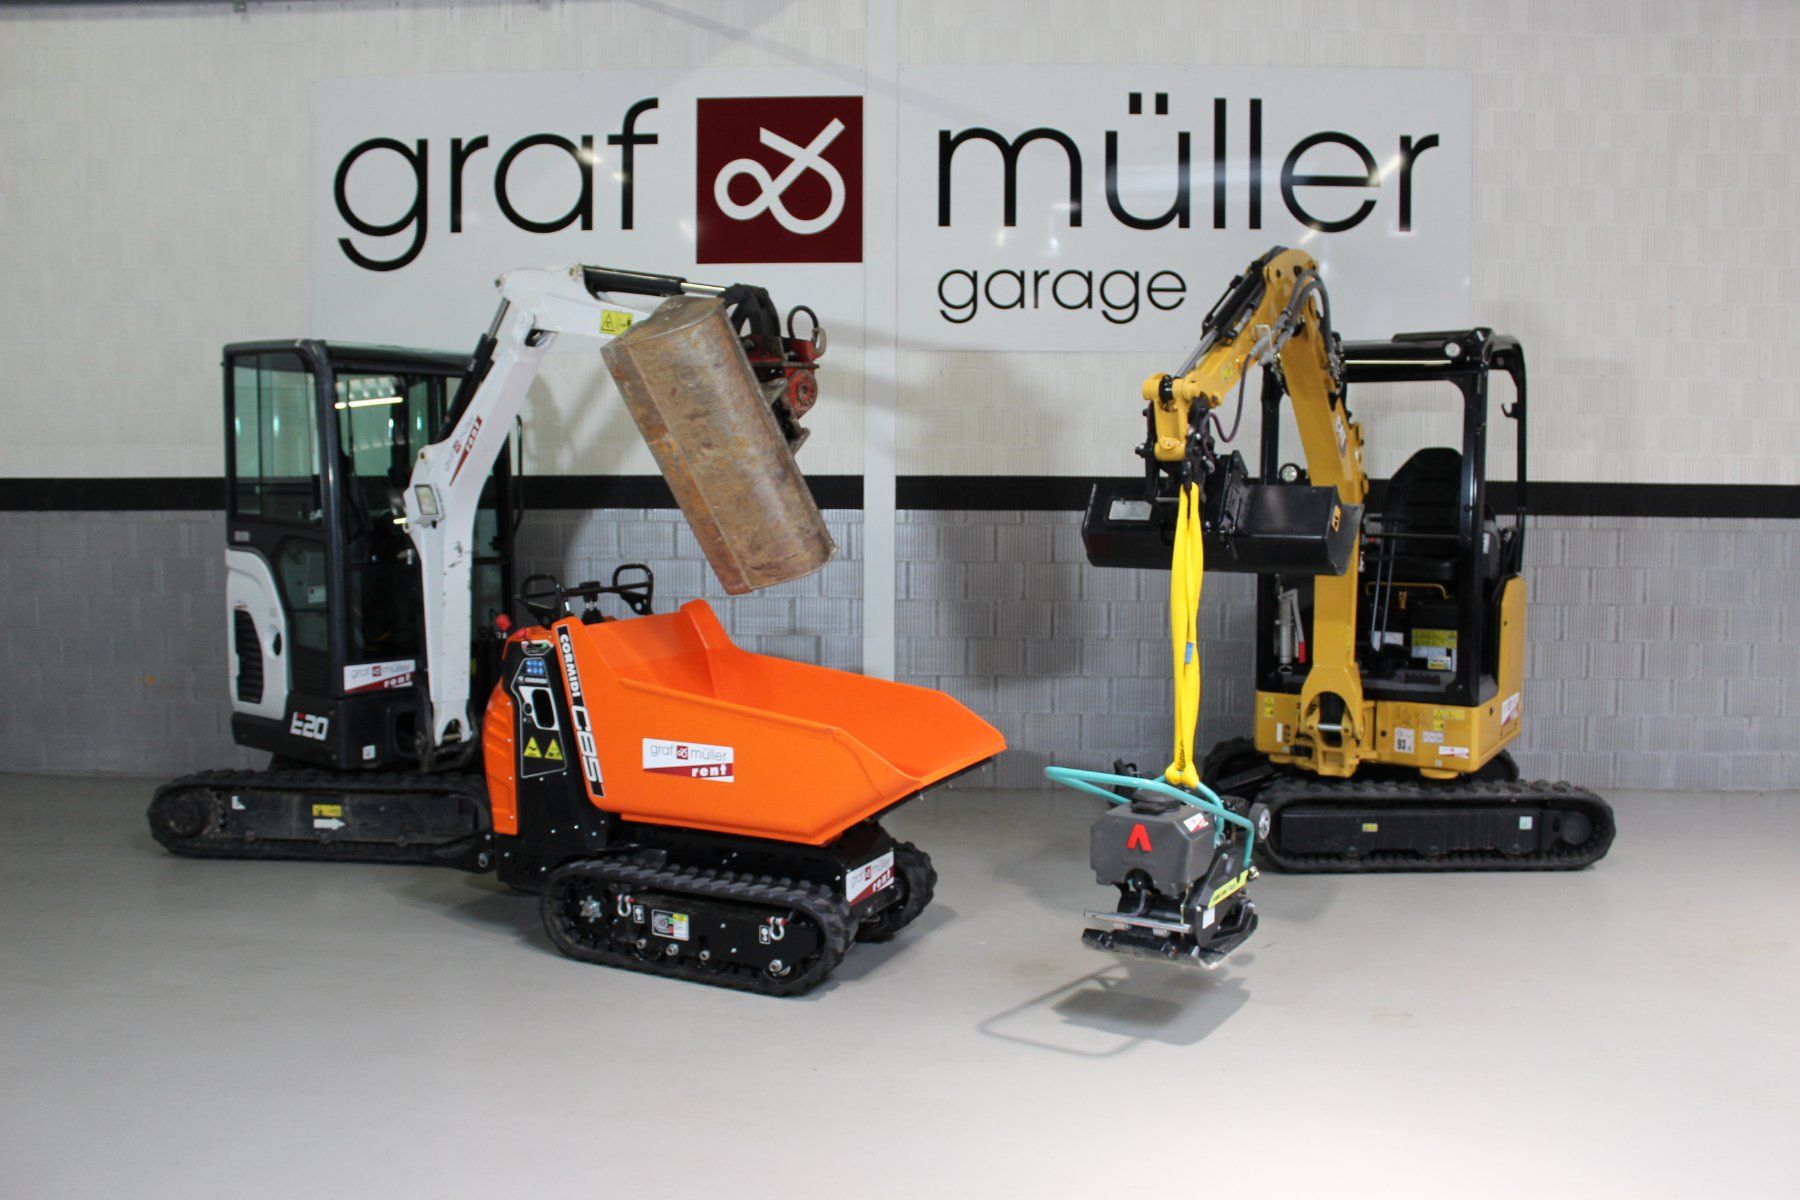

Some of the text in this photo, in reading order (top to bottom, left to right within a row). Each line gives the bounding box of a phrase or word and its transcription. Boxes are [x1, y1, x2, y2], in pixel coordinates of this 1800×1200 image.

[333, 97, 659, 272] graf
[938, 92, 1440, 233] müller
[938, 269, 1187, 324] garage
[290, 711, 329, 740] E20
[559, 633, 603, 784] CORMIDI C85
[649, 744, 674, 757] graf
[690, 747, 727, 761] müller
[691, 763, 727, 777] rent
